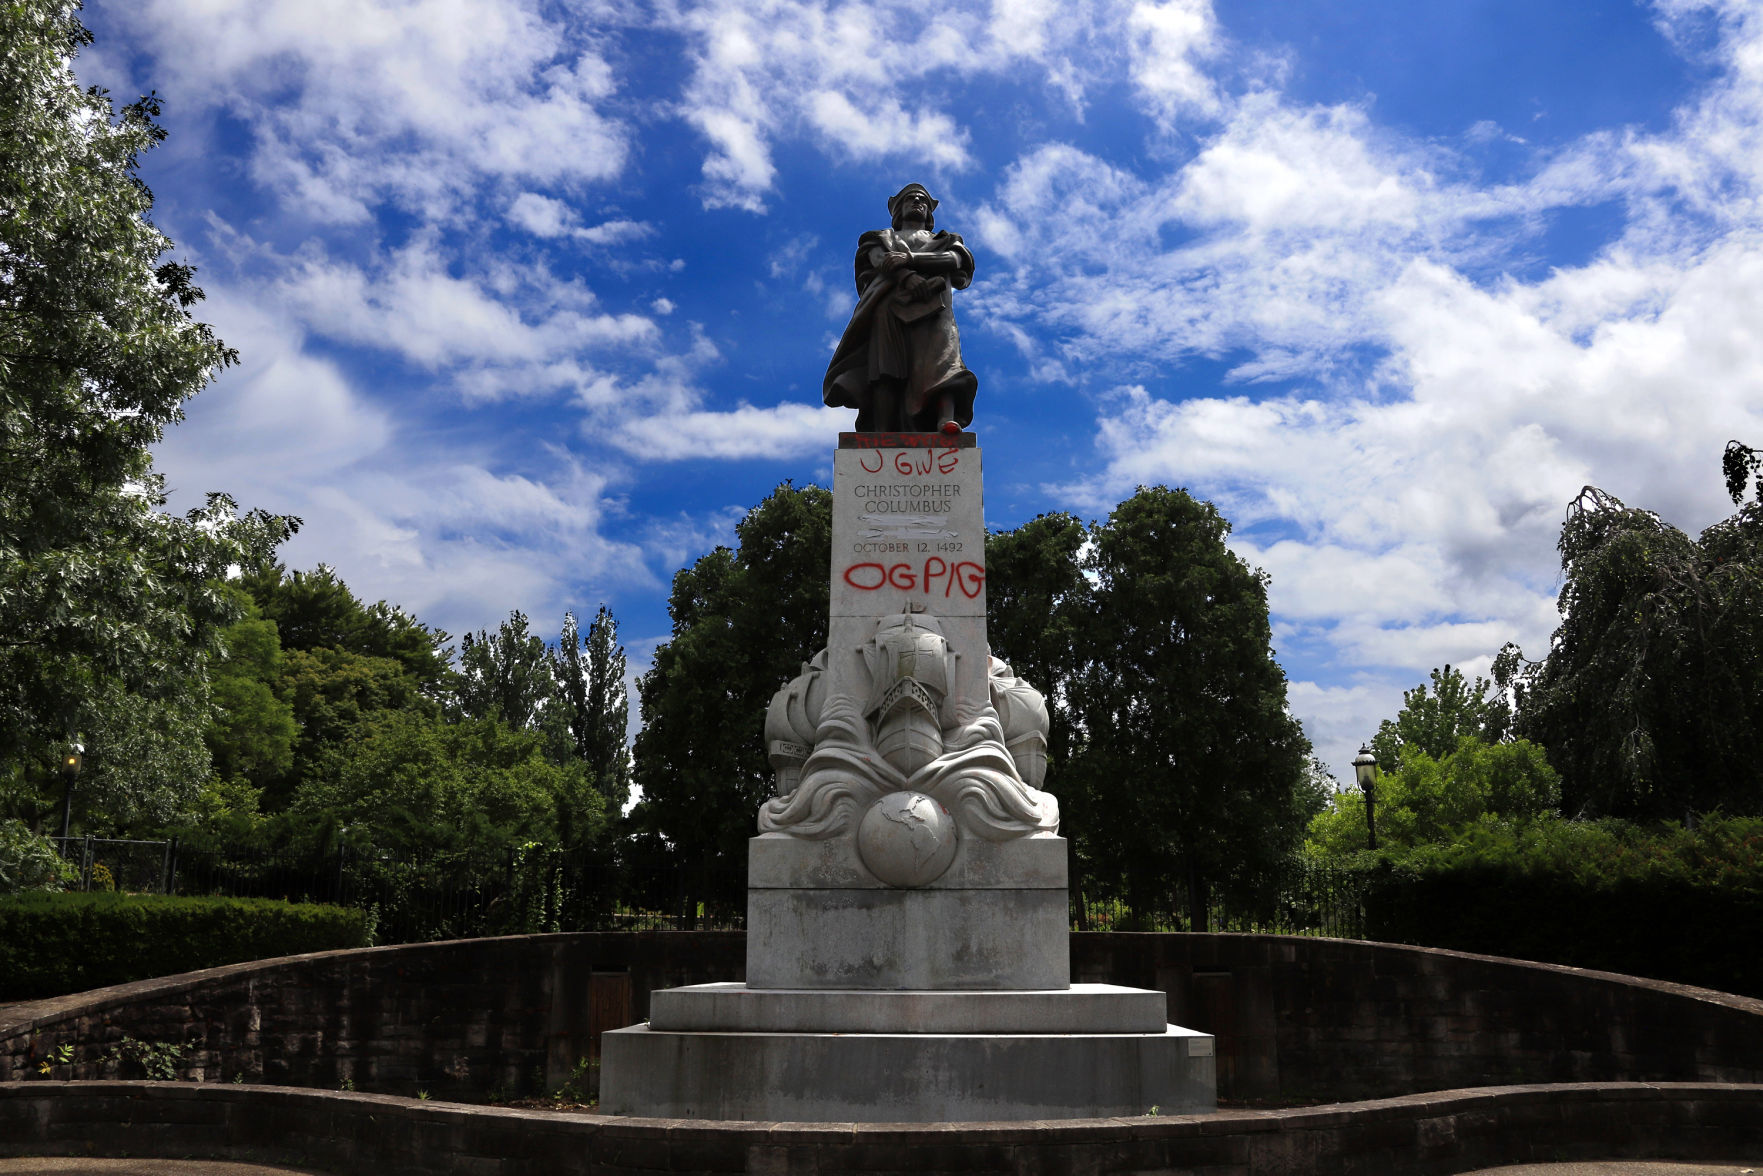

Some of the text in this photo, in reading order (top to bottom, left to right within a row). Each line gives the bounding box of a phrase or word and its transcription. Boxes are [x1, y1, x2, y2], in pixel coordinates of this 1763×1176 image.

[854, 485, 961, 497] CHRISTOPHER
[865, 501, 951, 513] COLUMBUS
[853, 543, 909, 552] OCTOBER
[937, 543, 963, 552] 1492
